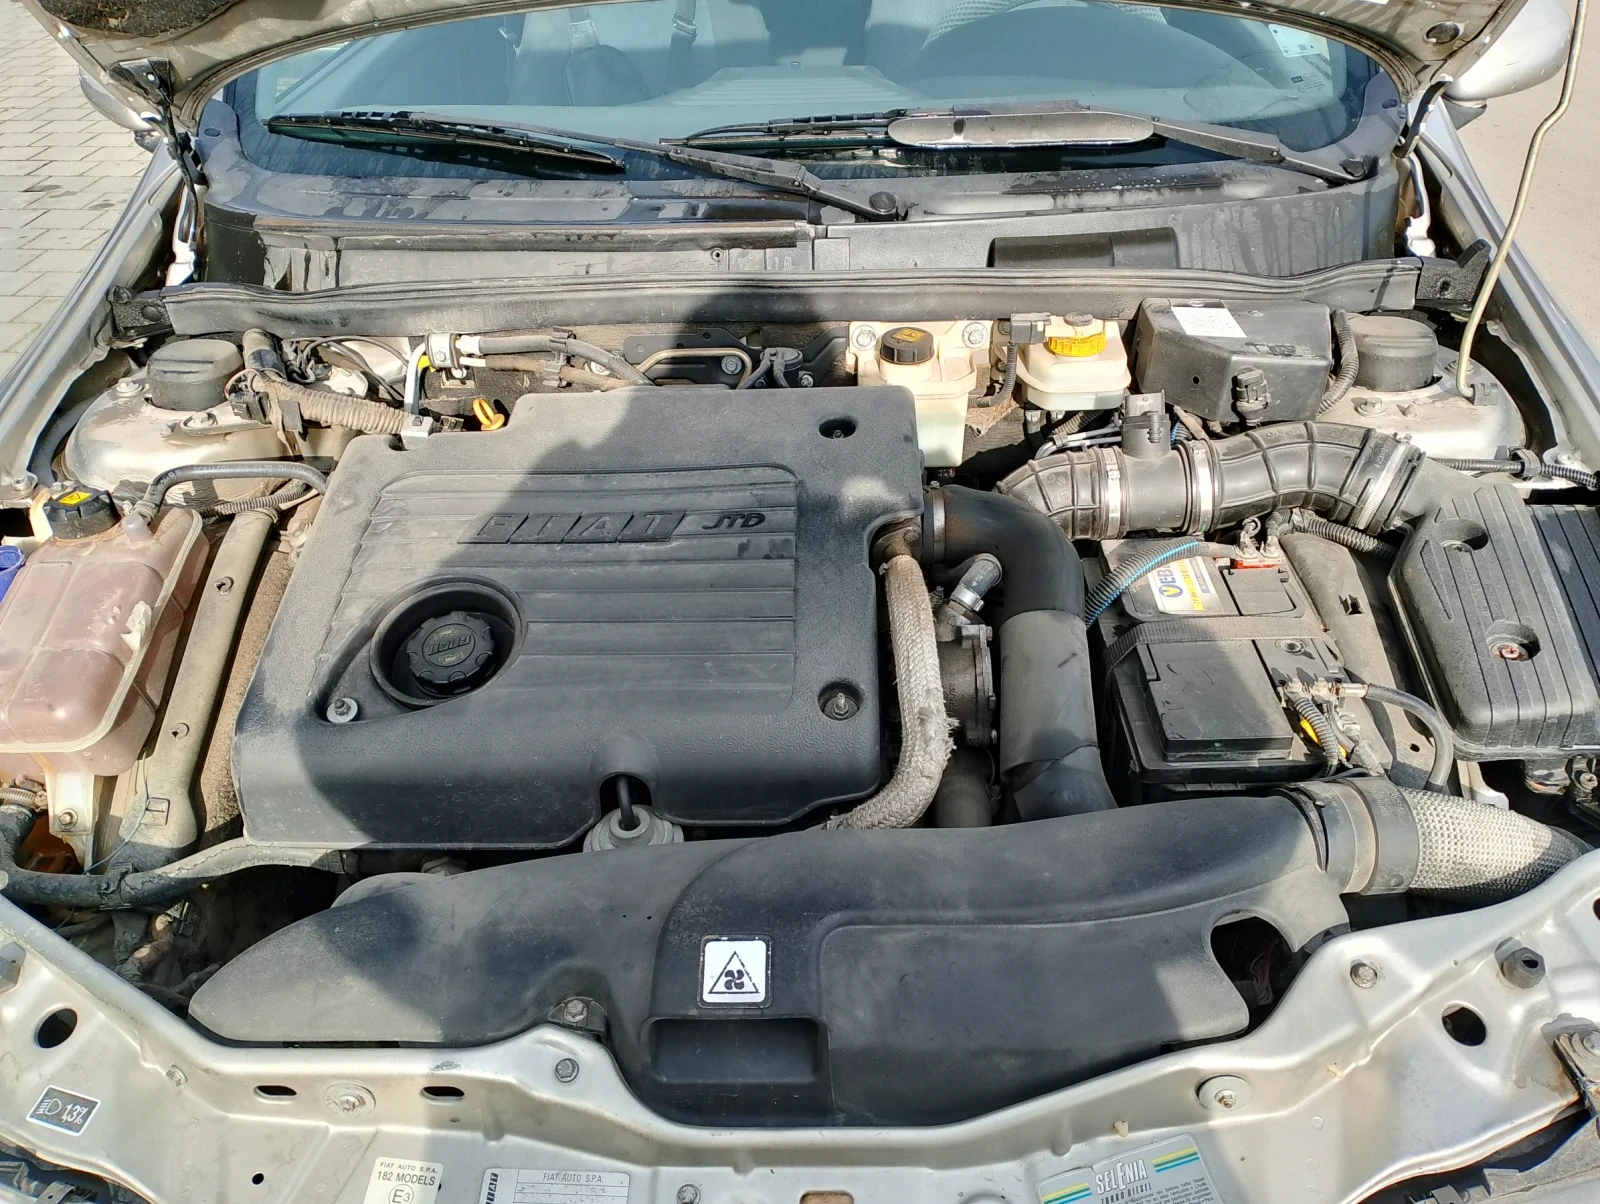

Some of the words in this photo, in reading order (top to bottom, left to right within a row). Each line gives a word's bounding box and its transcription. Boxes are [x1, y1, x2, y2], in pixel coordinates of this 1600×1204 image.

[470, 512, 680, 541] FIAT
[701, 512, 767, 531] JTD
[1156, 565, 1183, 598] VEB
[379, 1161, 395, 1169] FIAT
[397, 1163, 417, 1171] AUTO
[419, 1166, 438, 1174] S.P.A.
[377, 1170, 394, 1181] 182
[395, 1172, 436, 1187] MODELS
[542, 1172, 560, 1182] FIAT
[561, 1173, 582, 1183] AUTO
[585, 1174, 604, 1184] S.P.A.
[485, 1172, 499, 1204] IAT
[1127, 1182, 1153, 1198] DIESEL
